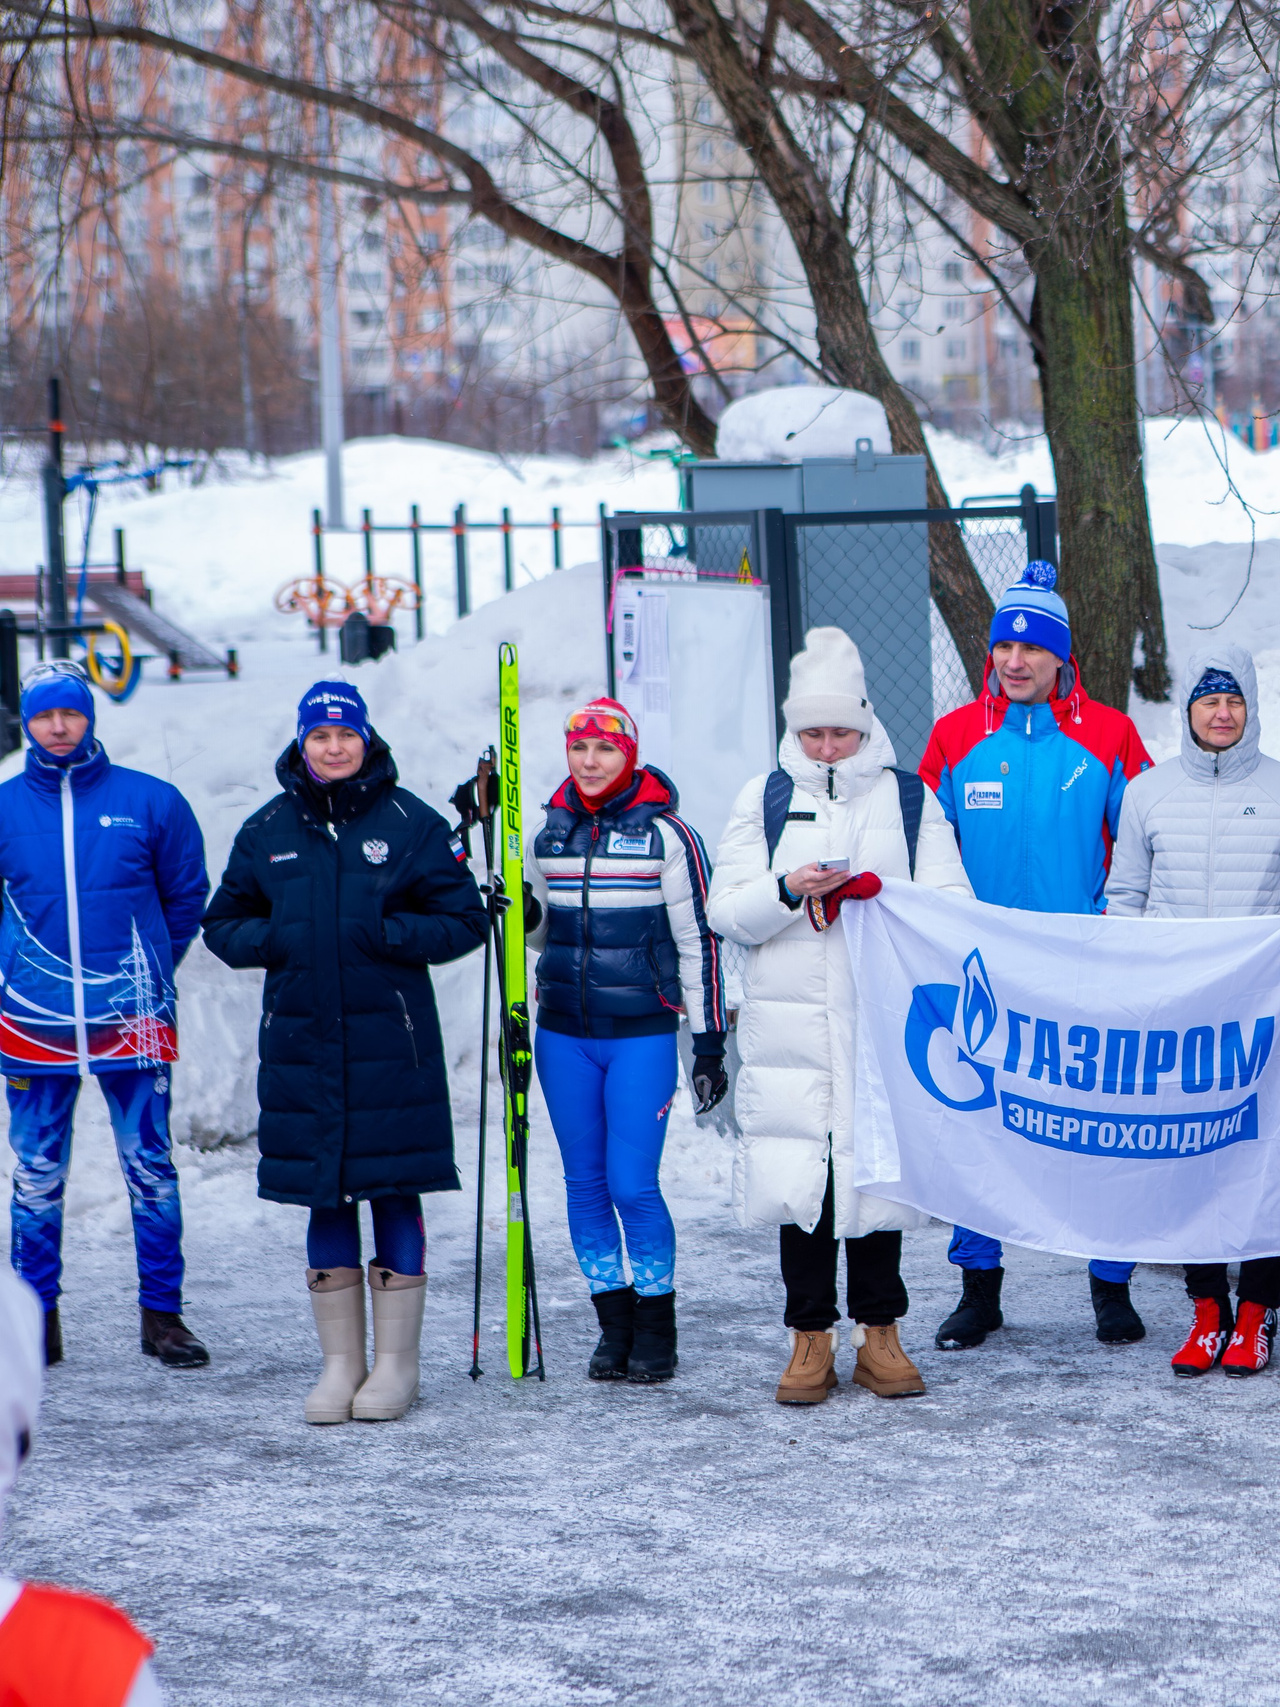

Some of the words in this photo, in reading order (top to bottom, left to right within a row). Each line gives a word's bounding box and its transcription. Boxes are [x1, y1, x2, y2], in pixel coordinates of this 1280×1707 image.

[505, 706, 519, 833] FISCHER
[1003, 1009, 1275, 1096] ГАЗПРОМ
[1008, 1103, 1250, 1154] ЭНЕРГОХОЛДИНГ
